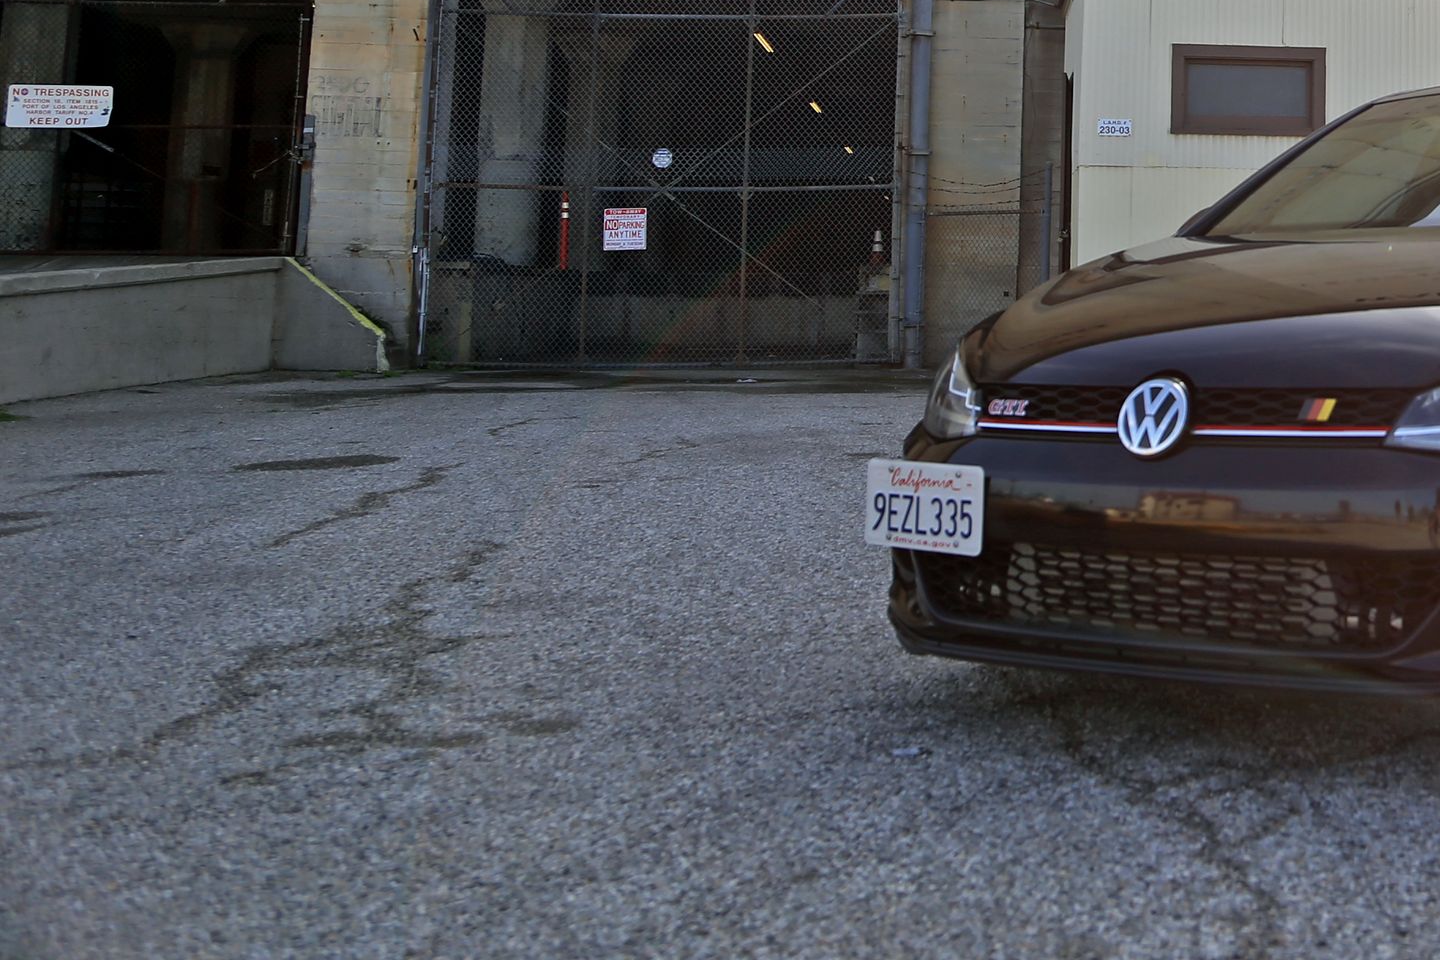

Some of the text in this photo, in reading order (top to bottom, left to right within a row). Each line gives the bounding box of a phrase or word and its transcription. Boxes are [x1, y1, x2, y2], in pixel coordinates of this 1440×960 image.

[13, 88, 109, 96] NO TRESPASSING
[1100, 126, 1130, 134] 230-03
[606, 220, 645, 229] NO PARKING
[608, 230, 642, 238] ANYTIME
[988, 399, 1029, 416] GTI
[1118, 378, 1188, 456] VW
[891, 467, 961, 493] California
[872, 492, 973, 539] 9EZL335
[893, 535, 951, 548] dmv.ca.gov
